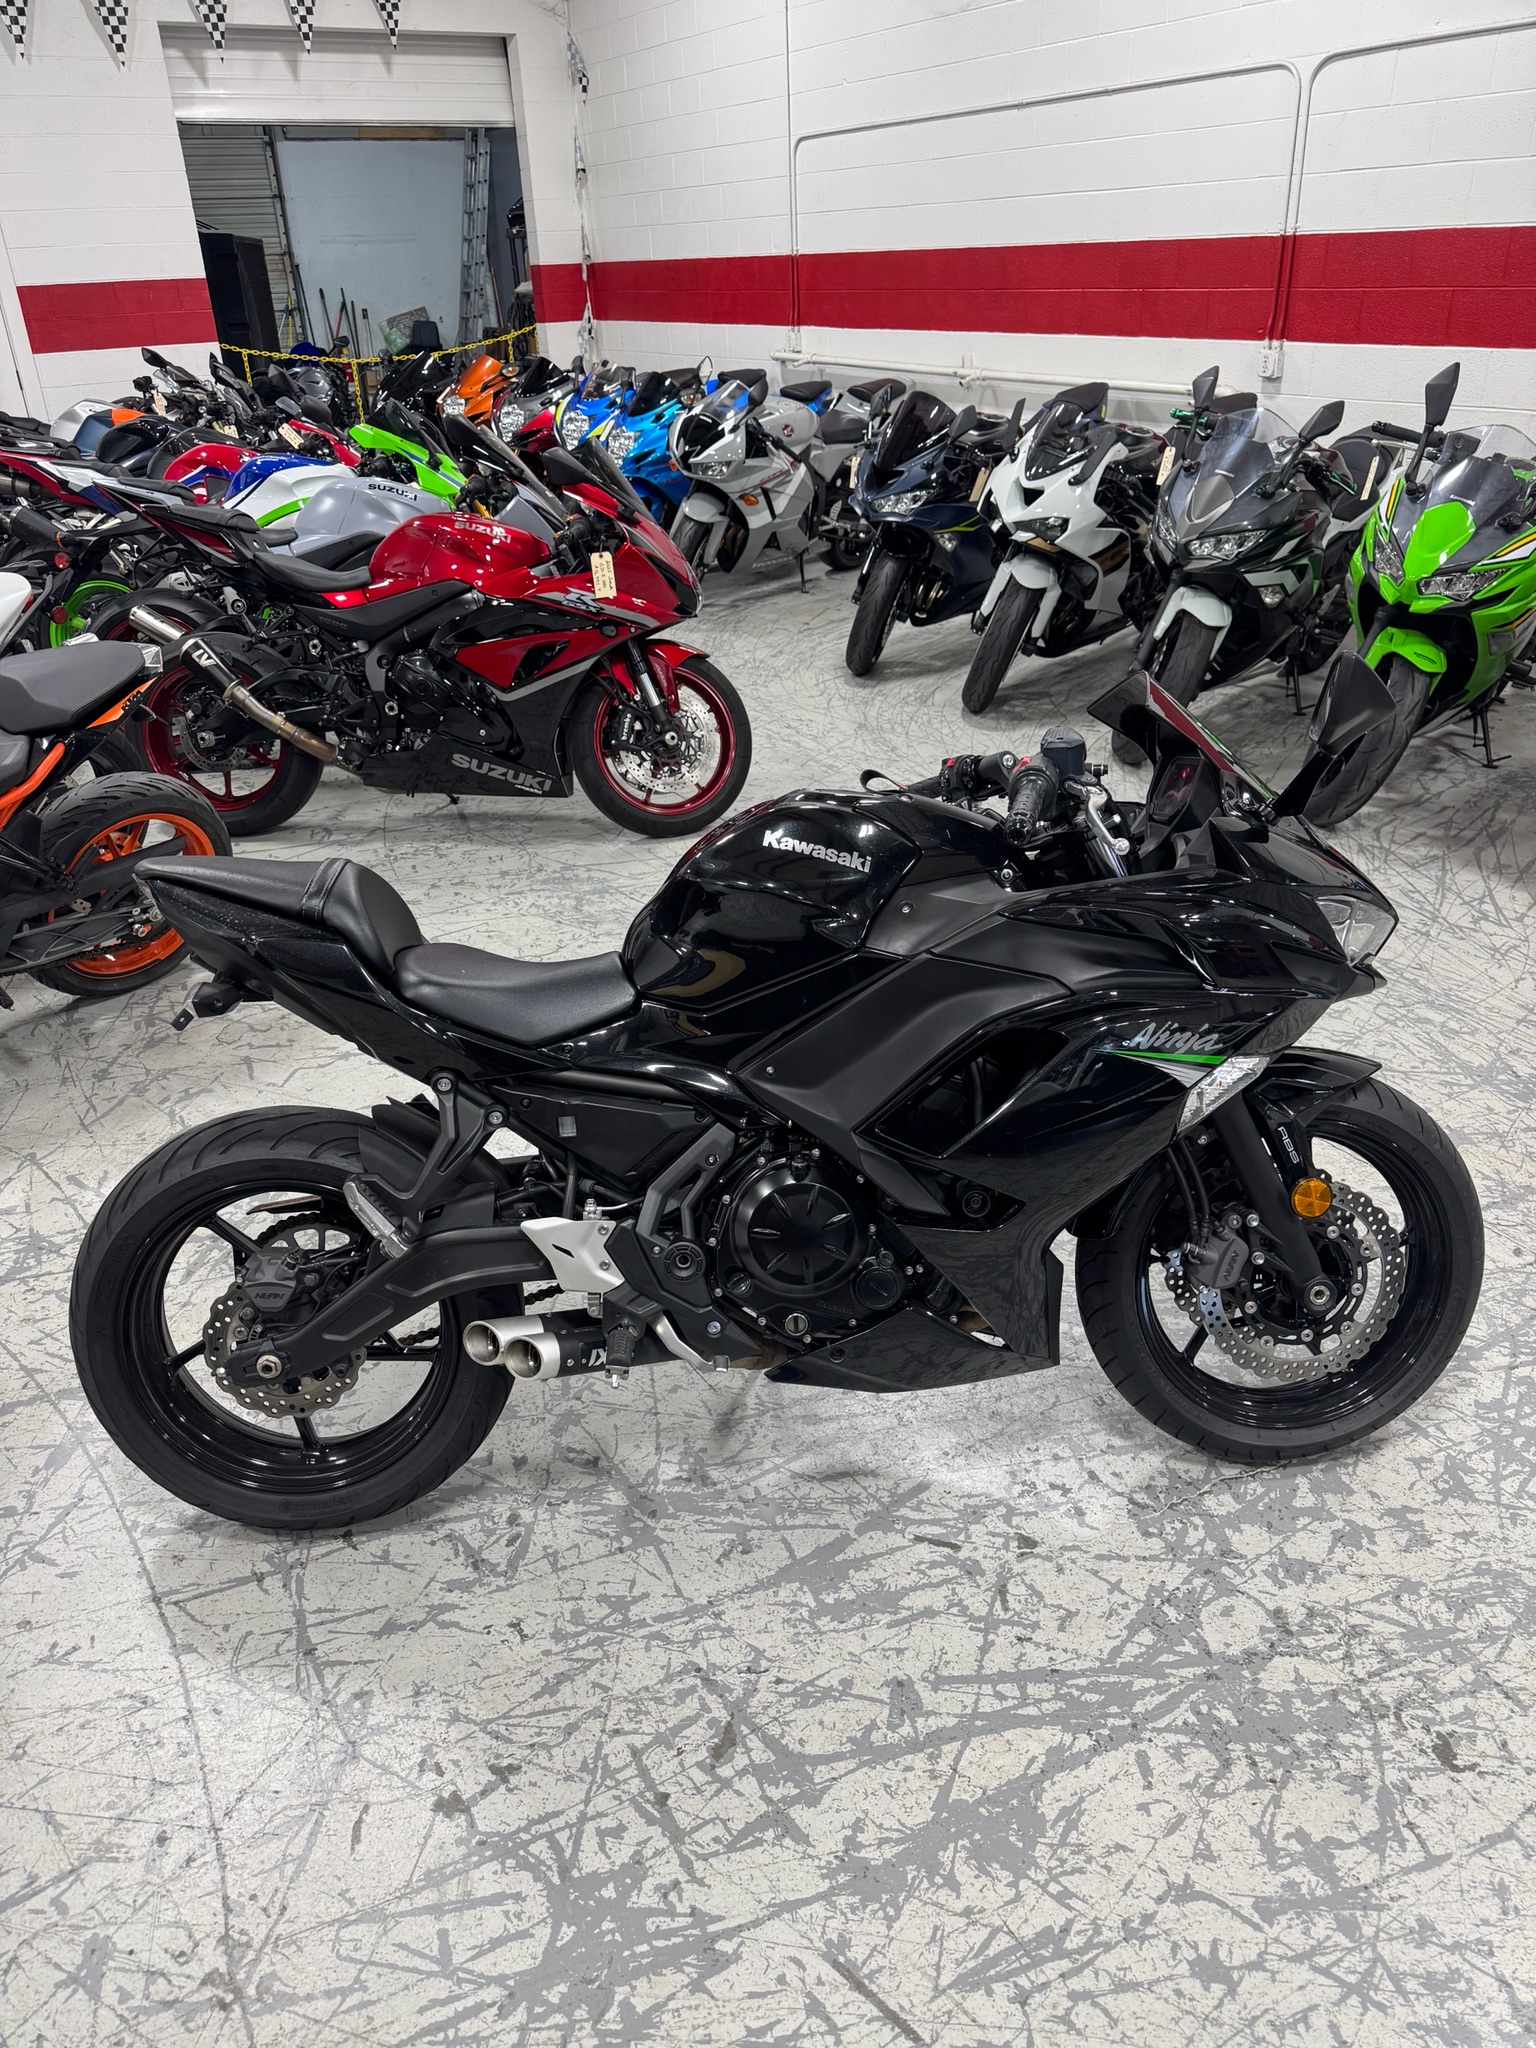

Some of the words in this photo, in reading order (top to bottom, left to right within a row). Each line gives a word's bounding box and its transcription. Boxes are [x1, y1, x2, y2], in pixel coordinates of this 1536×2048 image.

[454, 520, 511, 544] SUZUKI
[620, 713, 633, 741] brembo
[451, 752, 552, 792] SUZUKI
[762, 828, 873, 874] Kawasaki
[1129, 1021, 1224, 1054] Ninja
[1277, 1126, 1300, 1164] ABS
